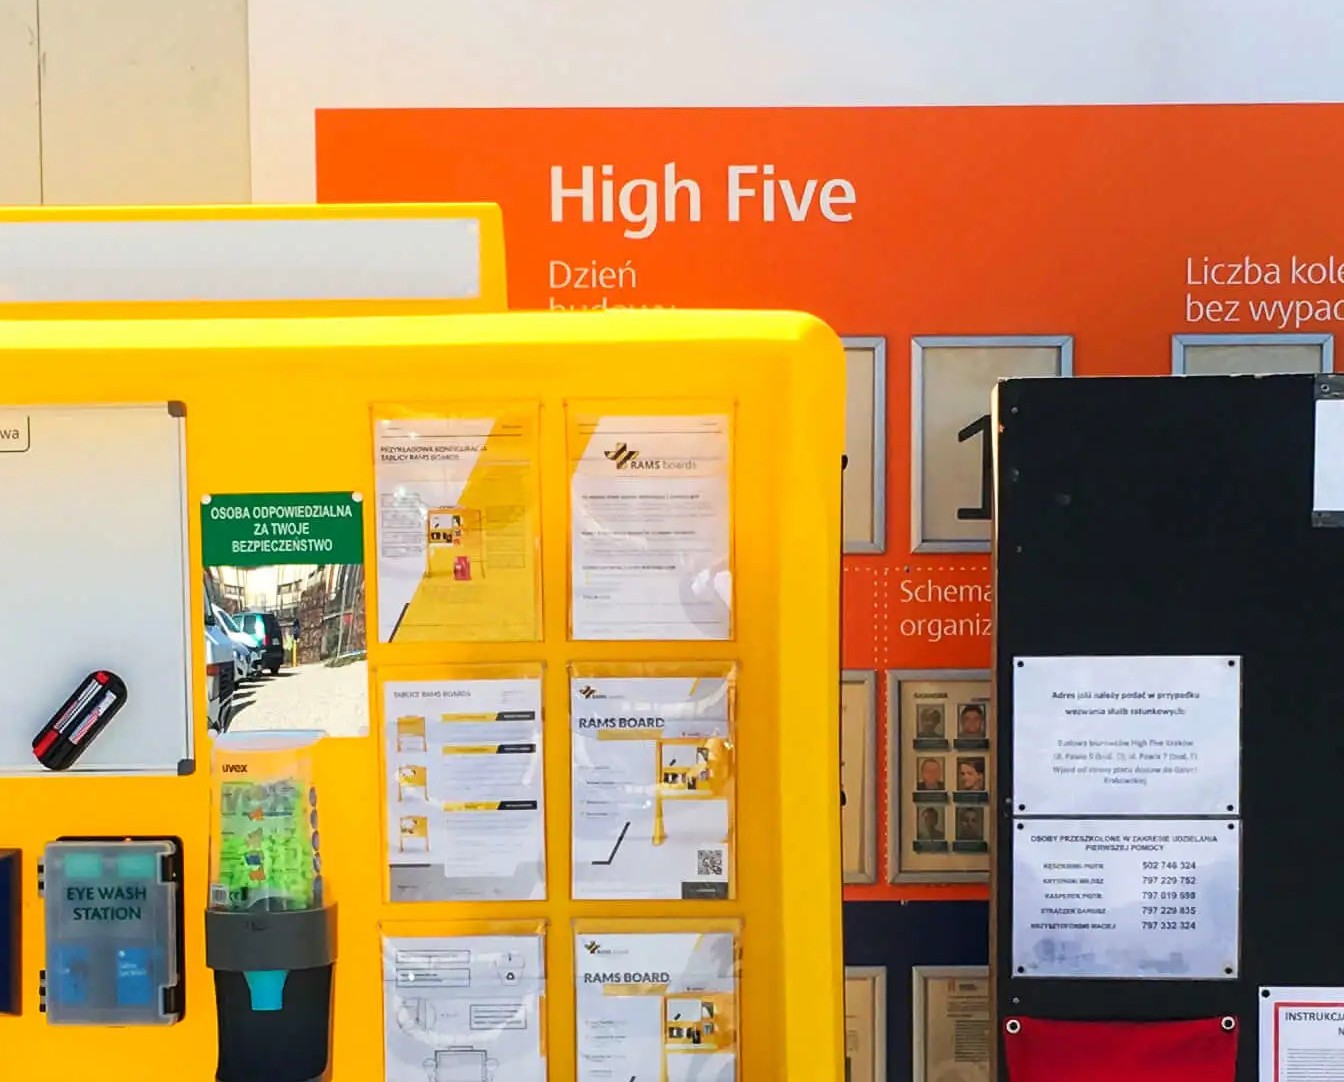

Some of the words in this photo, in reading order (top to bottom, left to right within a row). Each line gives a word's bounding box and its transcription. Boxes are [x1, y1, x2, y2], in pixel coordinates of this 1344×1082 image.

[550, 162, 701, 239] High
[727, 163, 857, 222] Five
[549, 260, 637, 289] Dzień
[1186, 256, 1281, 285] Liczba
[1186, 293, 1240, 322] bez
[630, 461, 660, 470] RAMS
[211, 507, 250, 519] OSOBA
[253, 505, 352, 519] ODPOWIEDZIALNA
[254, 523, 269, 535] ZA
[271, 523, 309, 535] TWOJE
[232, 537, 333, 552] BEZPIECZEŃSTWO
[579, 717, 616, 728] RAMS
[619, 717, 665, 728] BOARD
[222, 764, 248, 773] uvex
[1142, 876, 1158, 884] 797
[66, 887, 94, 900] EYE
[98, 886, 147, 900] WASH
[1142, 891, 1158, 899] 797
[73, 907, 141, 920] STATION
[584, 972, 621, 983] RAMS
[624, 972, 670, 983] BOARD
